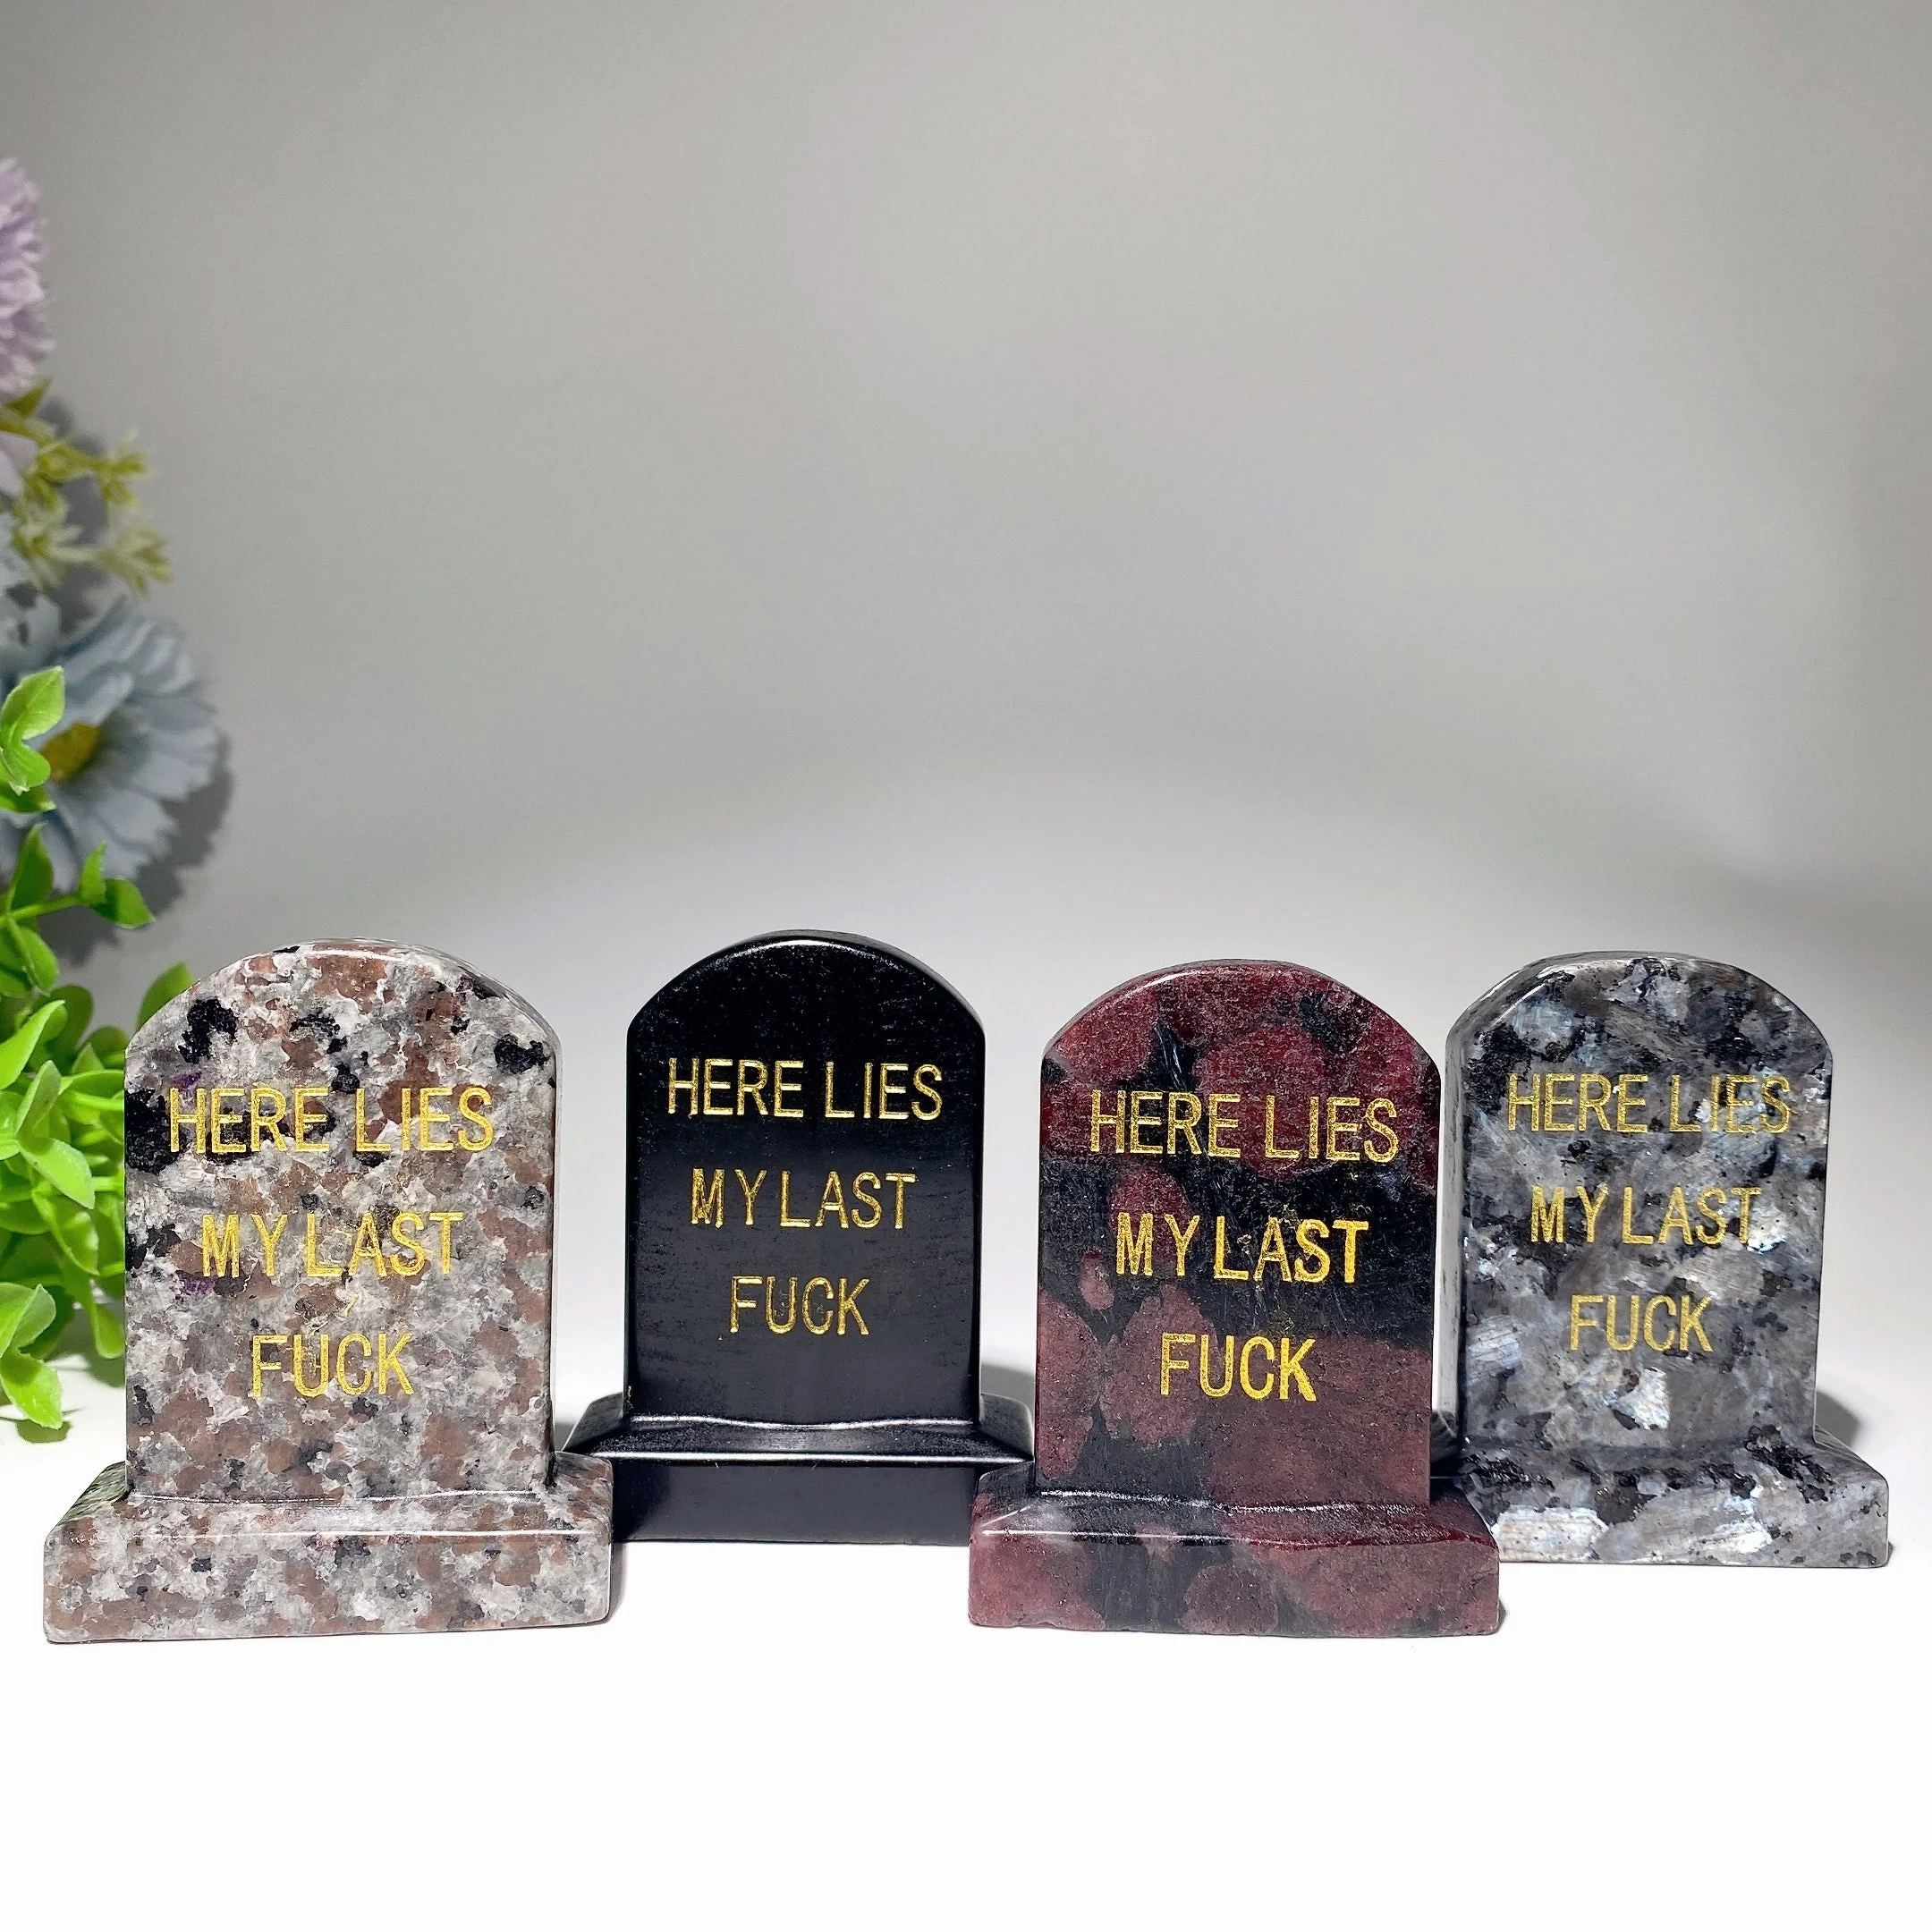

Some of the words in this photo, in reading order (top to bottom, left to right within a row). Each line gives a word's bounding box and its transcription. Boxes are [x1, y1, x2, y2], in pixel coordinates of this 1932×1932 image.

[668, 1059, 801, 1114] HERE
[825, 1064, 942, 1117] LIES
[1508, 1073, 1646, 1131] HERE
[1669, 1074, 1792, 1131] LIES
[166, 1084, 329, 1154] HERE
[353, 1086, 495, 1154] LIES
[1090, 1091, 1240, 1156] HERE
[1266, 1097, 1397, 1160] LIES
[691, 1168, 765, 1223] MY
[779, 1172, 913, 1226] LAST
[1530, 1188, 1606, 1241] MY
[1622, 1187, 1758, 1245] LAST
[199, 1213, 288, 1275] MY
[303, 1211, 464, 1278] LAST
[1116, 1213, 1199, 1274] MY
[1214, 1216, 1368, 1284] LAST
[730, 1276, 869, 1335] FUCK
[1571, 1294, 1710, 1352] FUCK
[251, 1334, 414, 1398] FUCK
[1161, 1334, 1317, 1401] FUCK
